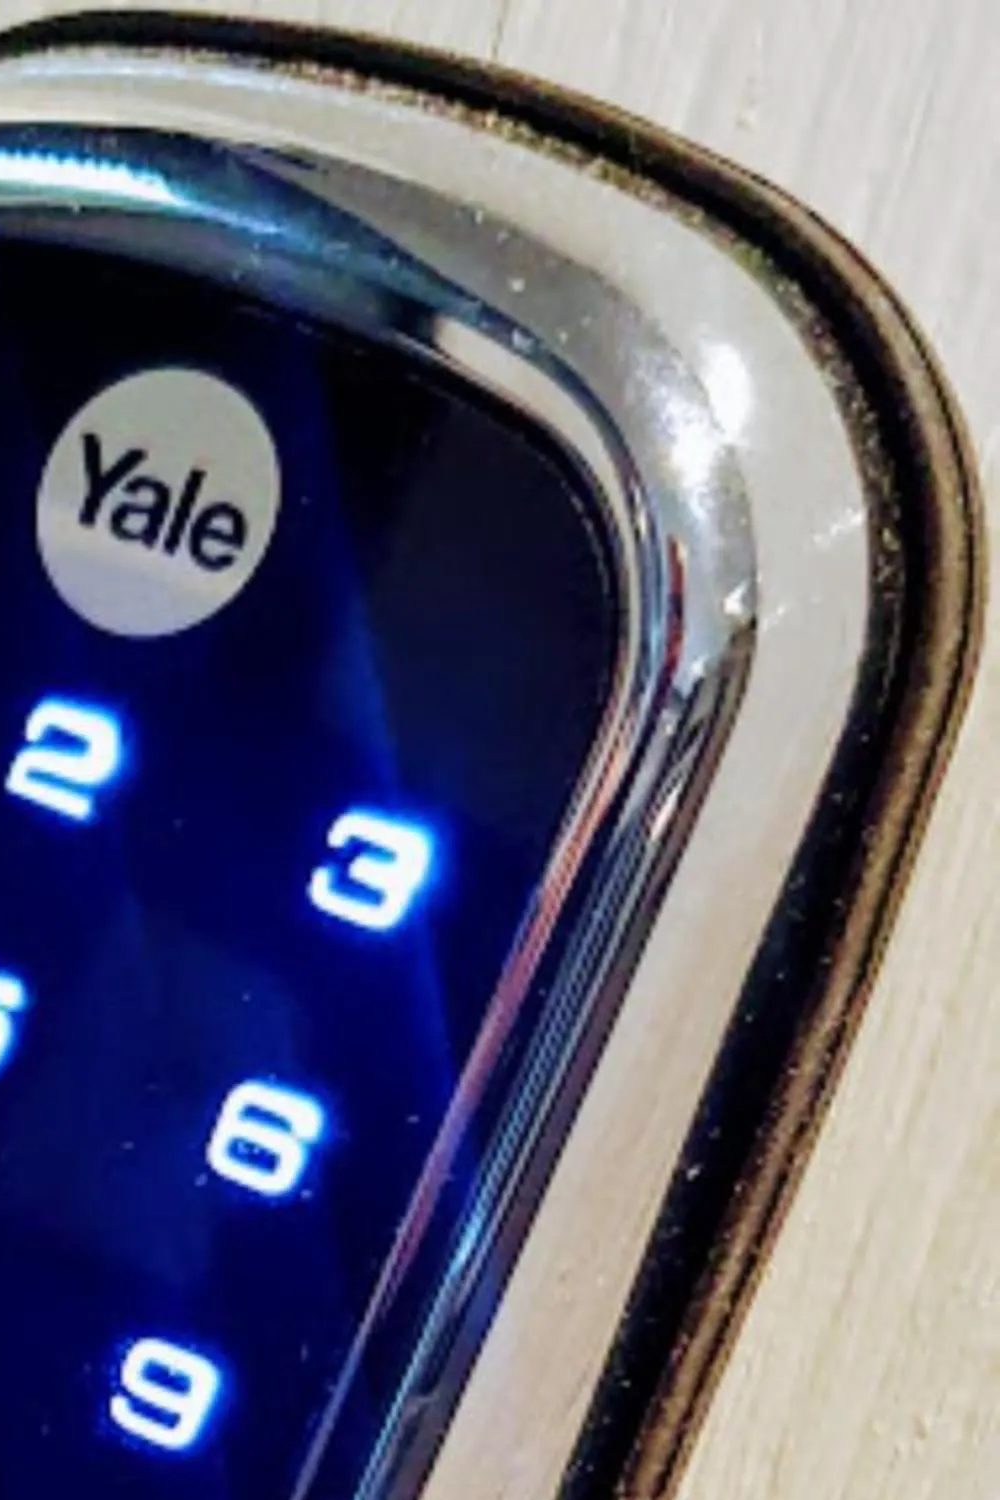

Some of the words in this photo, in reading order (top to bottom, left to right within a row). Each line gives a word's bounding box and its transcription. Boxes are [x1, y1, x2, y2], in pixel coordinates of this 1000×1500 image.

[78, 432, 248, 572] Yale
[3, 698, 124, 822] 2
[306, 808, 436, 933] 3
[204, 1079, 327, 1198] 6
[108, 1336, 223, 1452] 9
